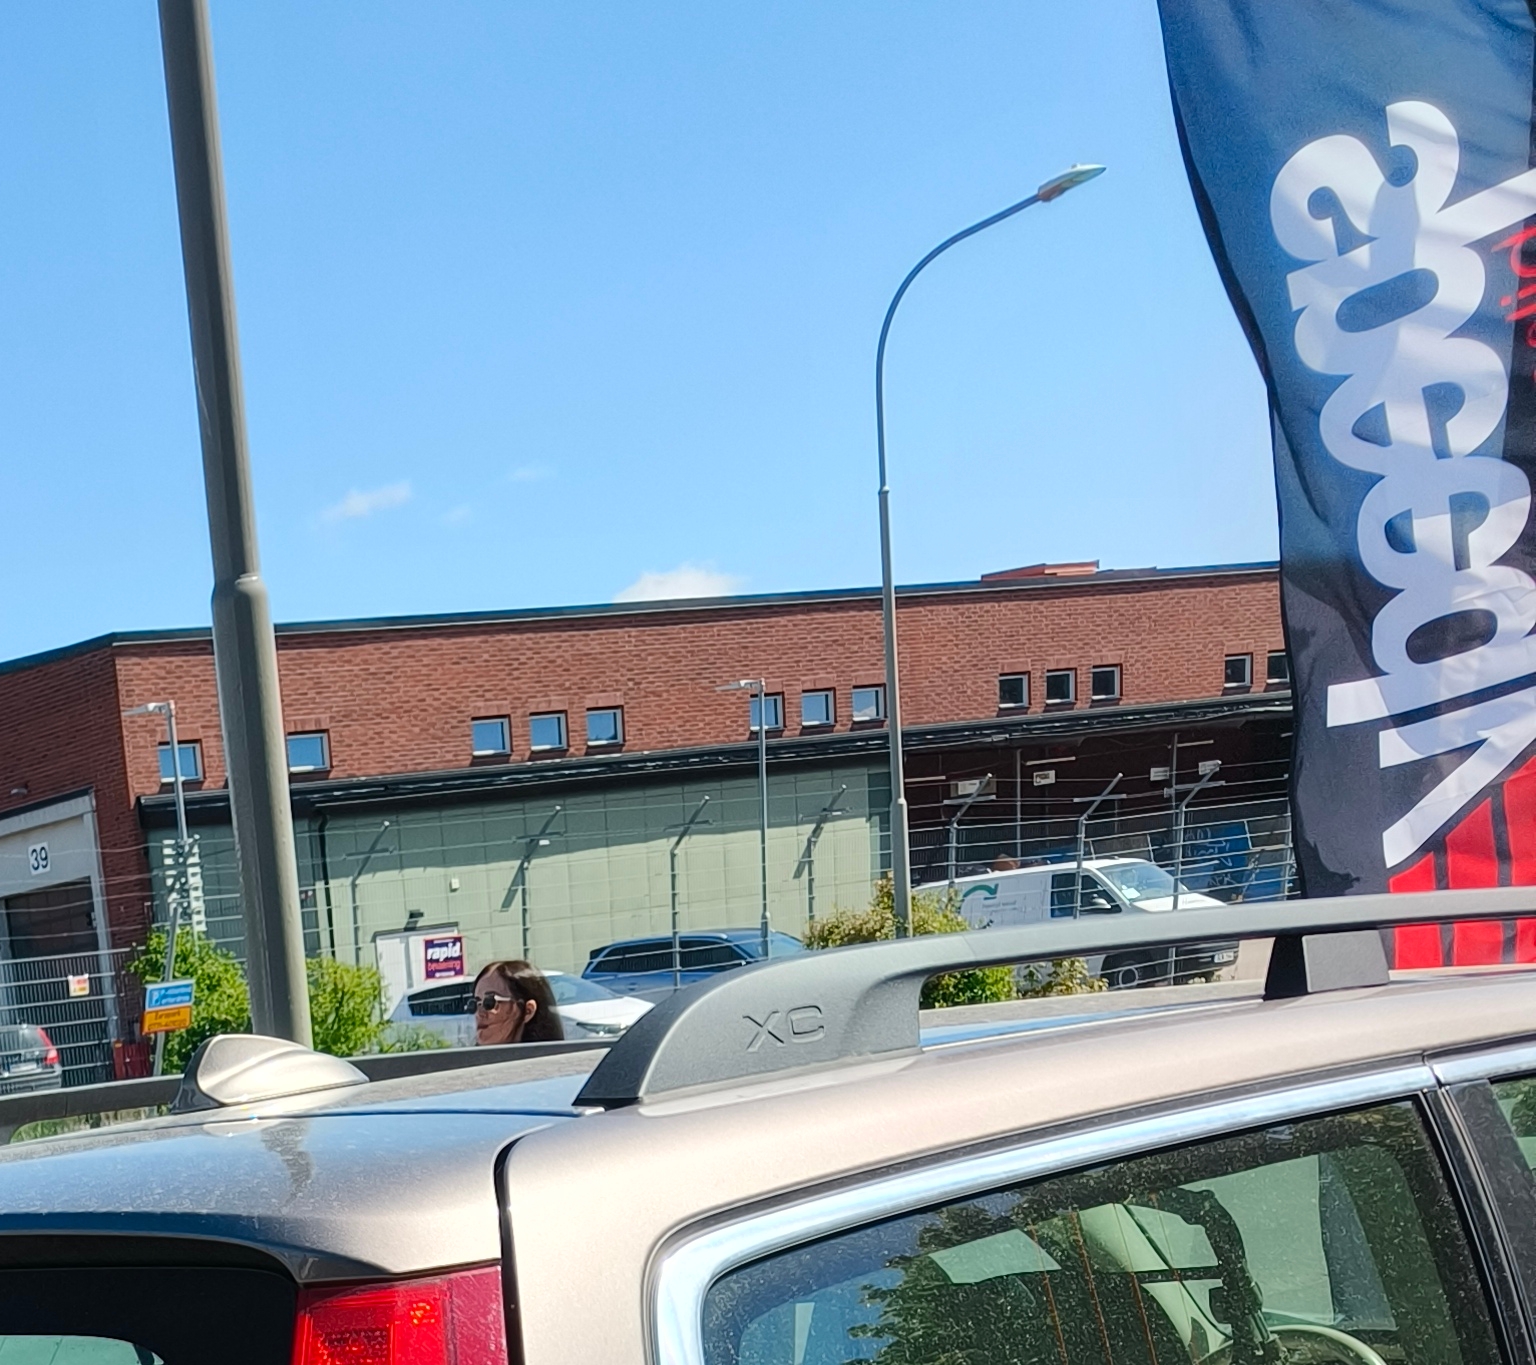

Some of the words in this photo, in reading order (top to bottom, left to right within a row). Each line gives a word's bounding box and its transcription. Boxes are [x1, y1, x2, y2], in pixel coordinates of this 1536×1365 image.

[30, 846, 49, 872] 39
[427, 941, 461, 962] rapid
[742, 1004, 825, 1053] XC
